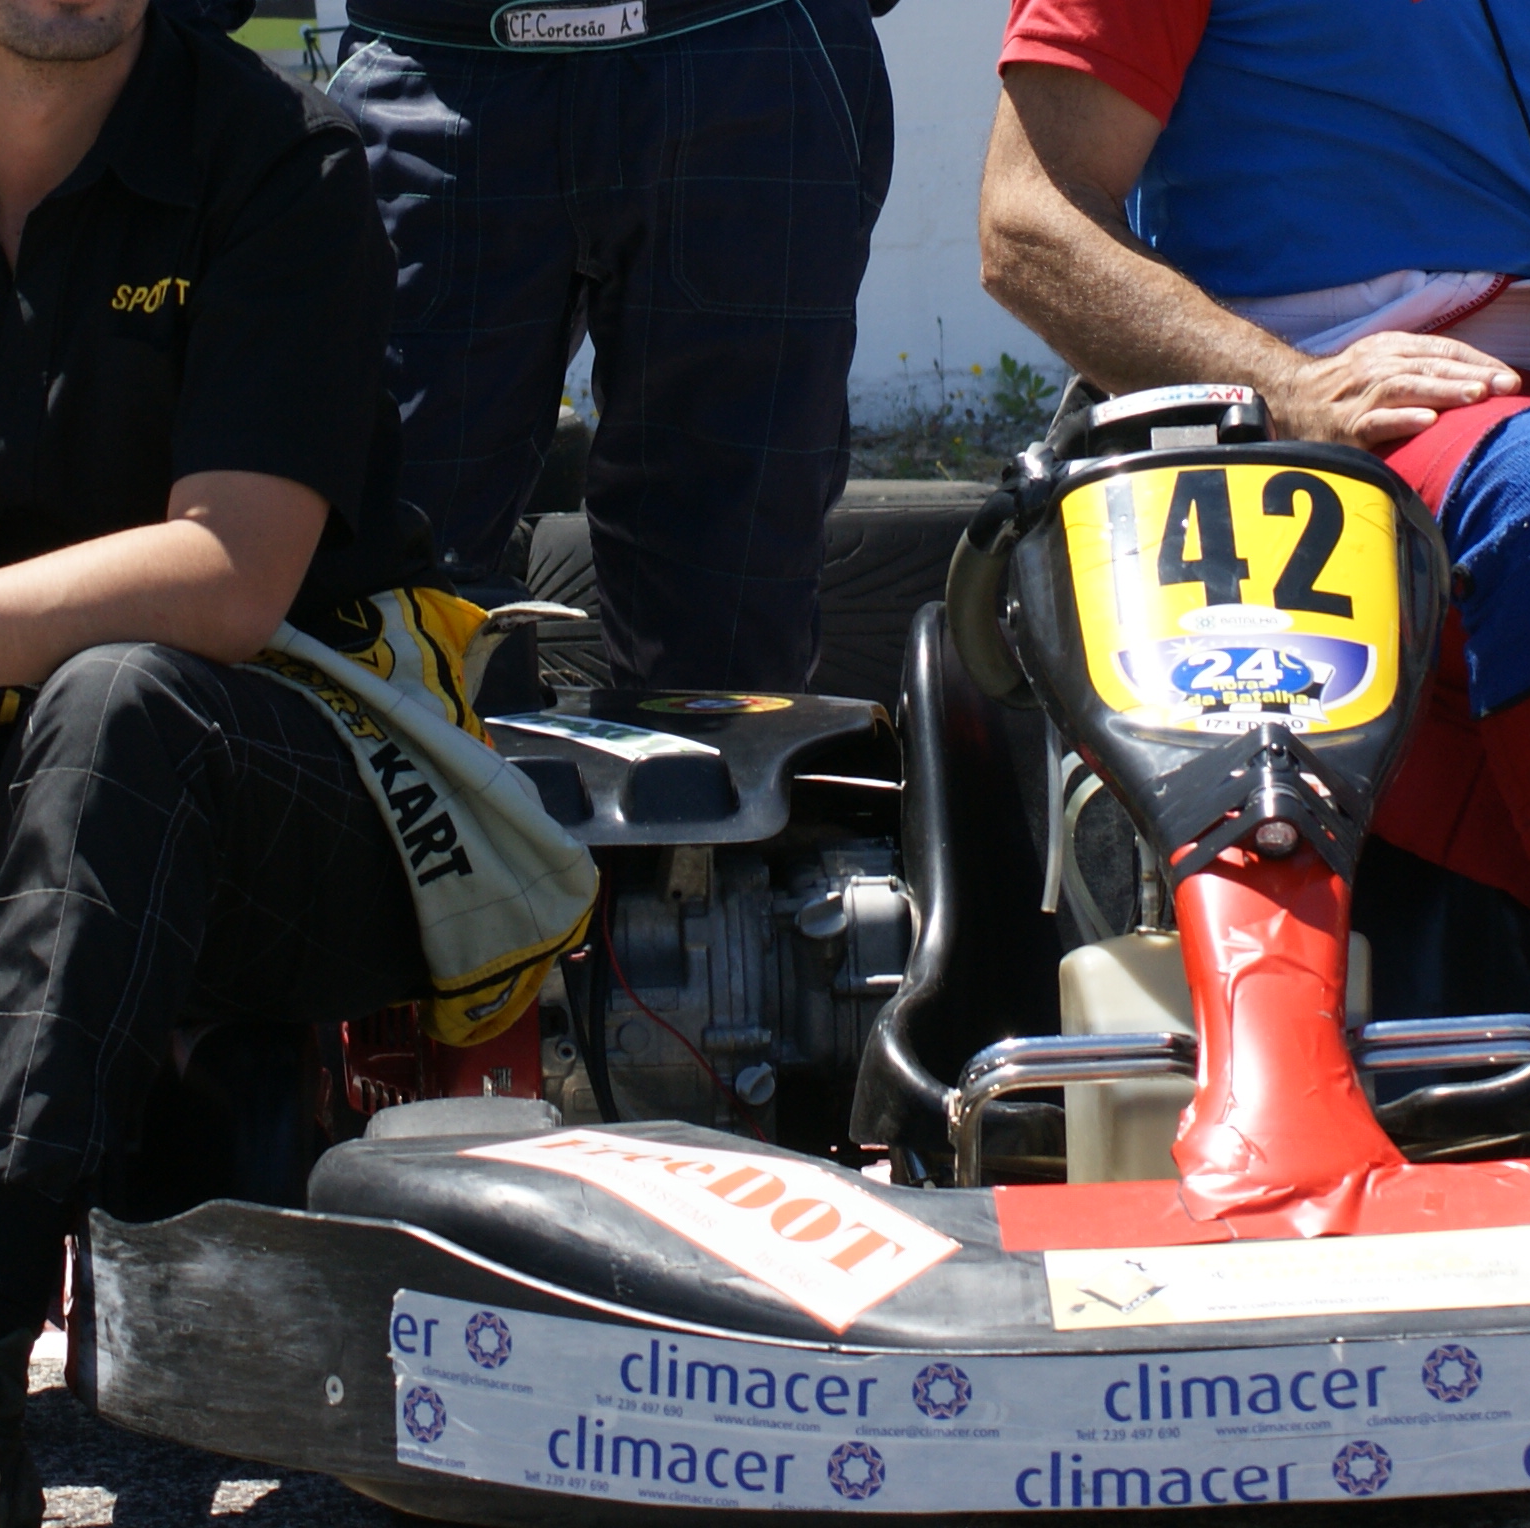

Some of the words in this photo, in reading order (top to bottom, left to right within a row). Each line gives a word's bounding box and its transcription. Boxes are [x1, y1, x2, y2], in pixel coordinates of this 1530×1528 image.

[1157, 468, 1354, 620] 42
[1188, 648, 1284, 689] 24
[1222, 689, 1310, 706] Batalha
[369, 742, 473, 886] KART
[538, 1138, 906, 1274] FreeDOT
[393, 1312, 439, 1357] er
[620, 1339, 878, 1417] climacer
[1105, 1363, 1387, 1422] climacer
[618, 1398, 638, 1410] 239
[641, 1401, 660, 1414] 497
[663, 1404, 683, 1417] 690
[1103, 1428, 1125, 1441] 239
[1131, 1427, 1153, 1440] 497
[546, 1473, 565, 1486] 239
[567, 1476, 587, 1489] 497
[590, 1479, 609, 1492] 690
[548, 1415, 794, 1494] climacer
[1015, 1451, 1298, 1508] climacer
